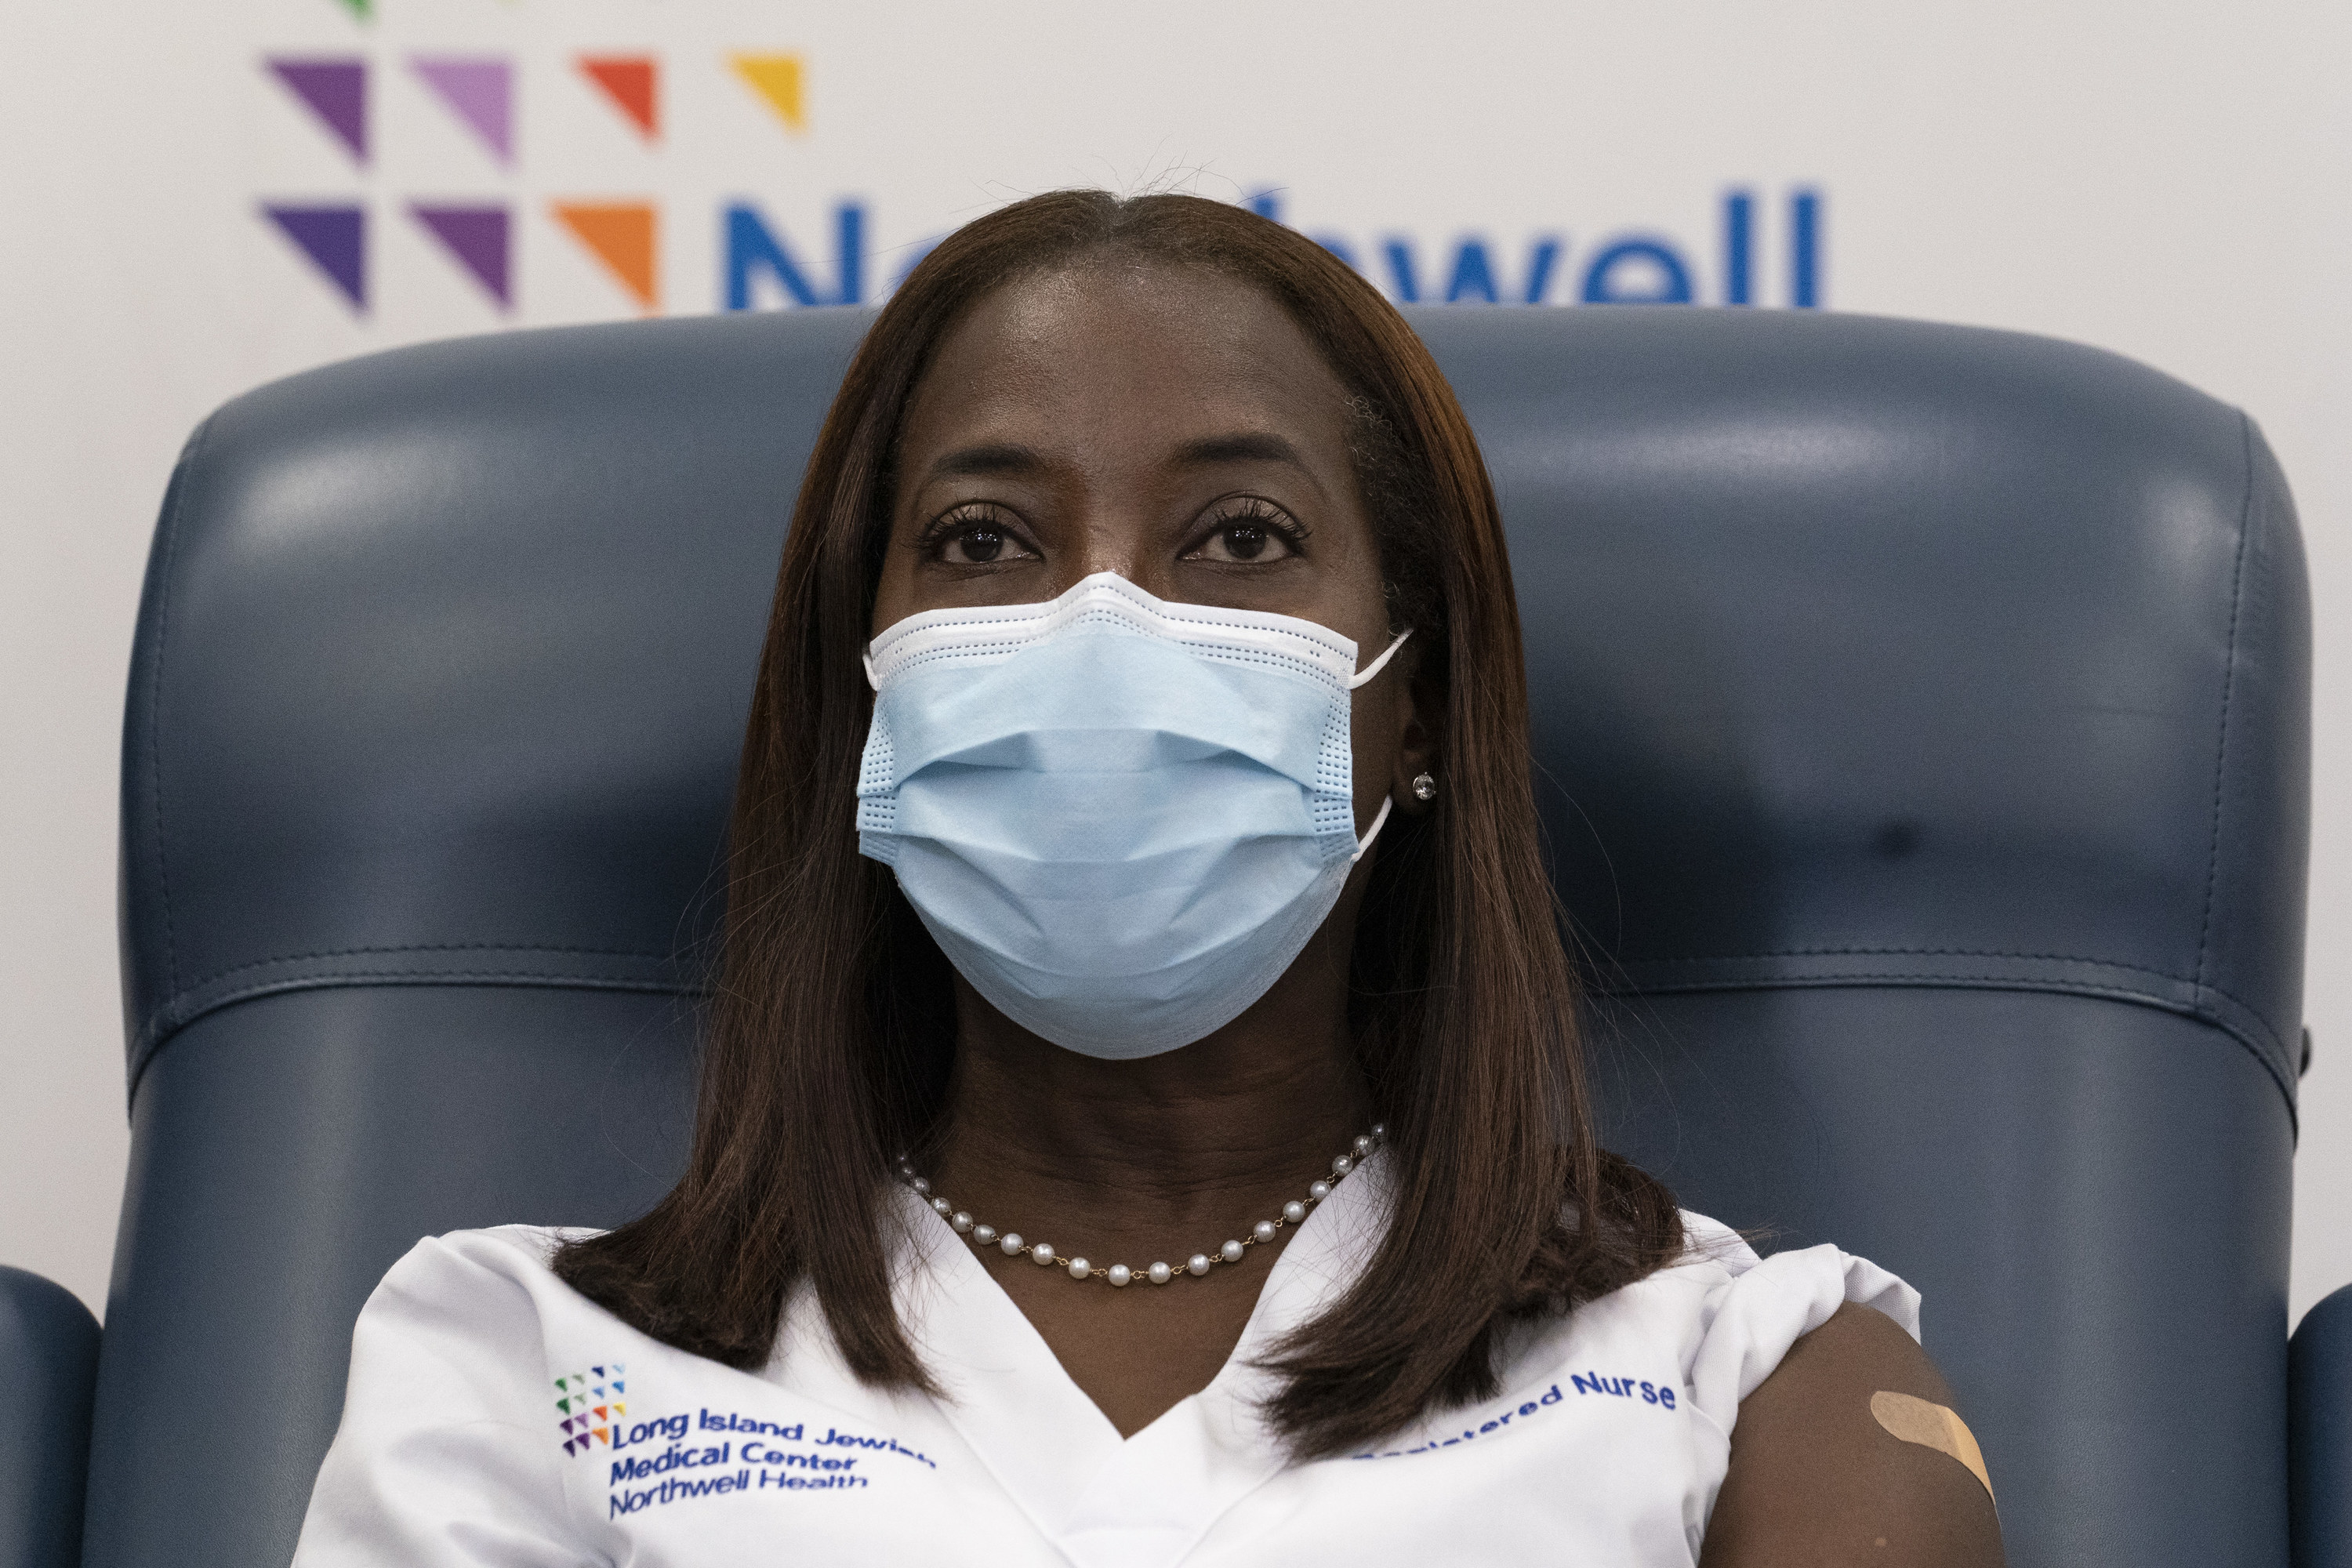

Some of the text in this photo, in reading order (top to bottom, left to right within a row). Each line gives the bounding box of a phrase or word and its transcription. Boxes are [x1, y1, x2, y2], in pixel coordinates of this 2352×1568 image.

[1570, 1370, 1676, 1410] Nurse
[612, 1412, 690, 1450] Long
[699, 1407, 804, 1441] Island
[609, 1441, 858, 1486] Medical Center
[609, 1468, 868, 1521] Northwell Health
